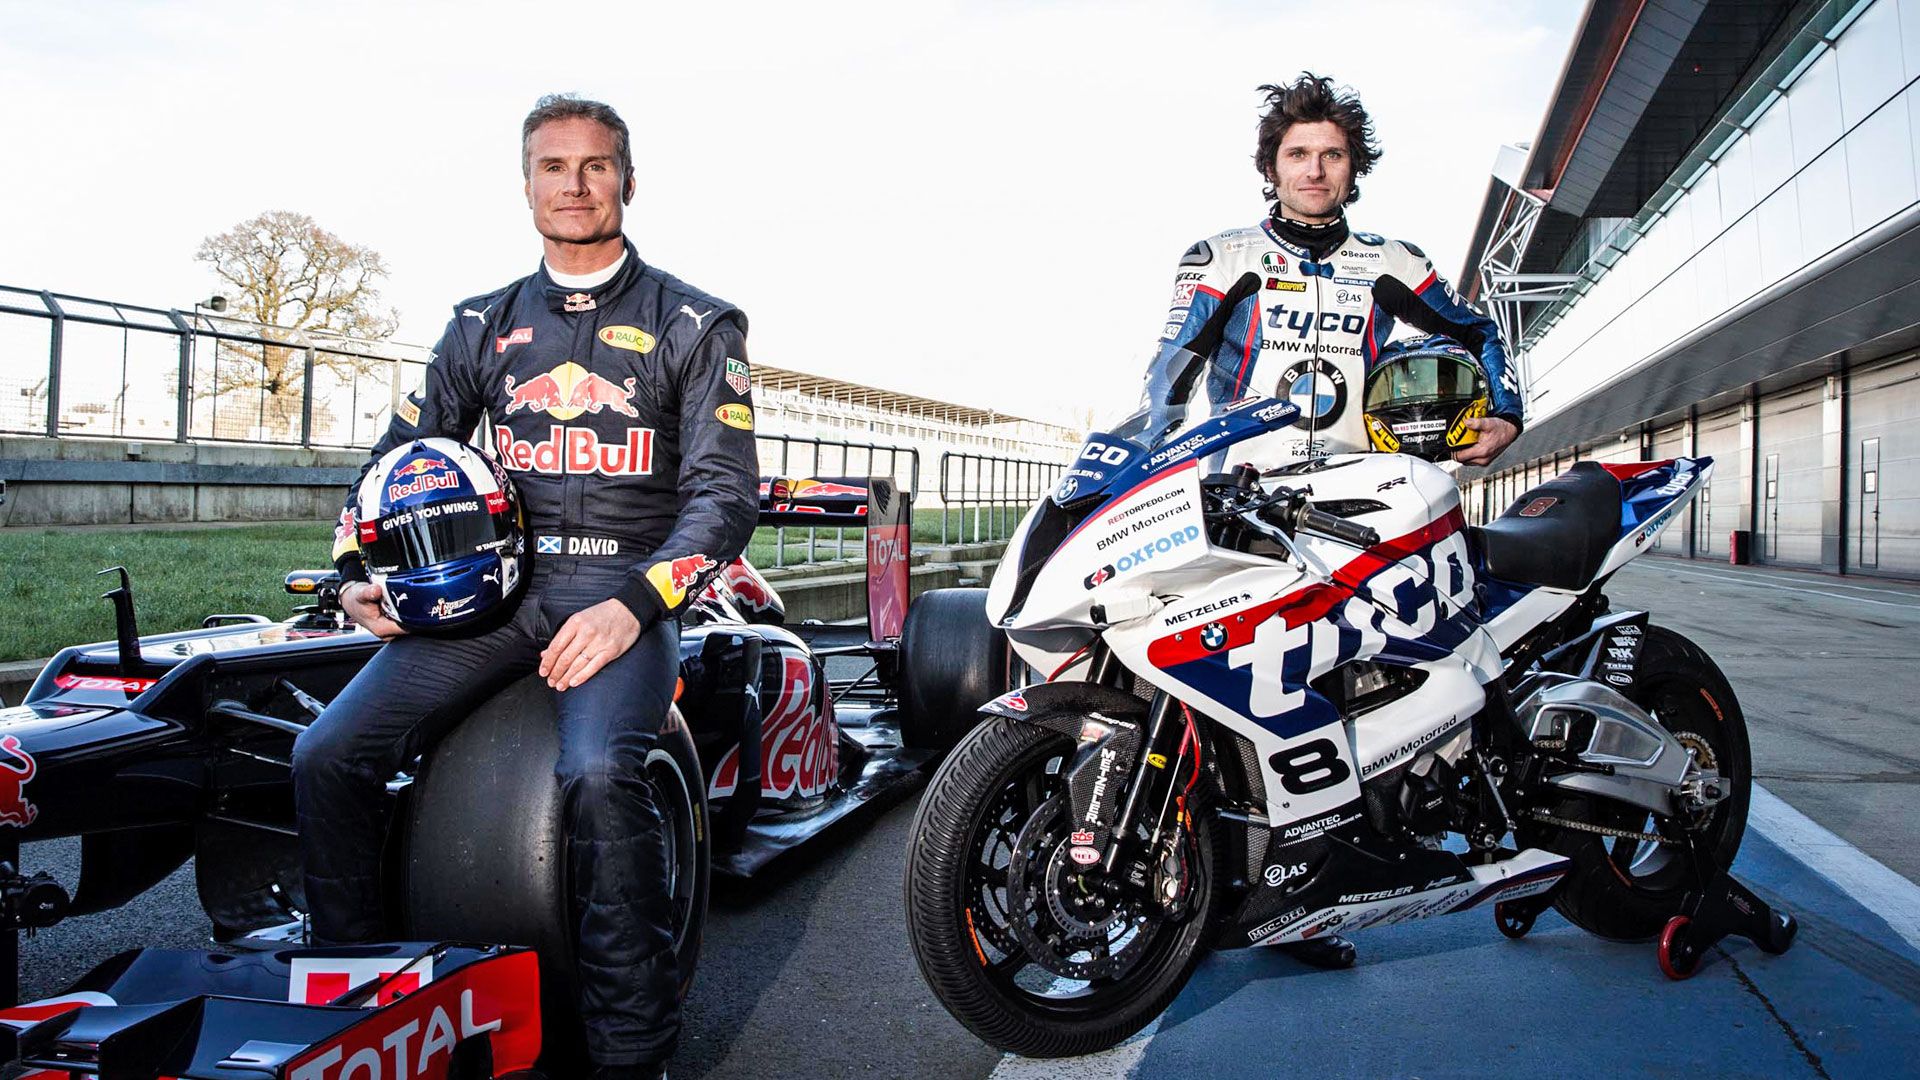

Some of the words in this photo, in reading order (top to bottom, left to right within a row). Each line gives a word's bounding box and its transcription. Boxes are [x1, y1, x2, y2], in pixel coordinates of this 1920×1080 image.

[1348, 250, 1380, 259] Beacon
[1266, 304, 1365, 339] tyco
[615, 331, 650, 348] RAUCH
[1261, 339, 1301, 352] BMW
[1304, 343, 1363, 357] Motorrad
[495, 425, 564, 474] Red
[565, 427, 655, 476] Bull
[1150, 434, 1205, 466] ADVANTEC
[1402, 433, 1440, 444] Snap-on
[388, 479, 422, 503] Red
[423, 470, 460, 491] Bull
[1656, 470, 1694, 496] tyco
[382, 512, 414, 531] GIVES
[416, 505, 441, 520] YOU
[442, 501, 479, 515] WINGS
[1107, 487, 1186, 526] REDTORPEDO.COM
[1096, 527, 1130, 552] BMW
[1131, 501, 1192, 534] Motorrad
[568, 537, 619, 556] DAVID
[871, 533, 906, 567] TOTAL
[1116, 524, 1200, 573] OXFORD
[1164, 595, 1239, 627] METZELER
[1228, 531, 1475, 718] tyco
[1607, 647, 1634, 658] RK
[1361, 750, 1399, 777] BMW
[1400, 714, 1458, 757] Motorrad
[1268, 737, 1351, 795] 8
[1085, 747, 1117, 824] METZELER
[1284, 814, 1341, 839] ADVANTEC
[1339, 885, 1414, 903] METZELER
